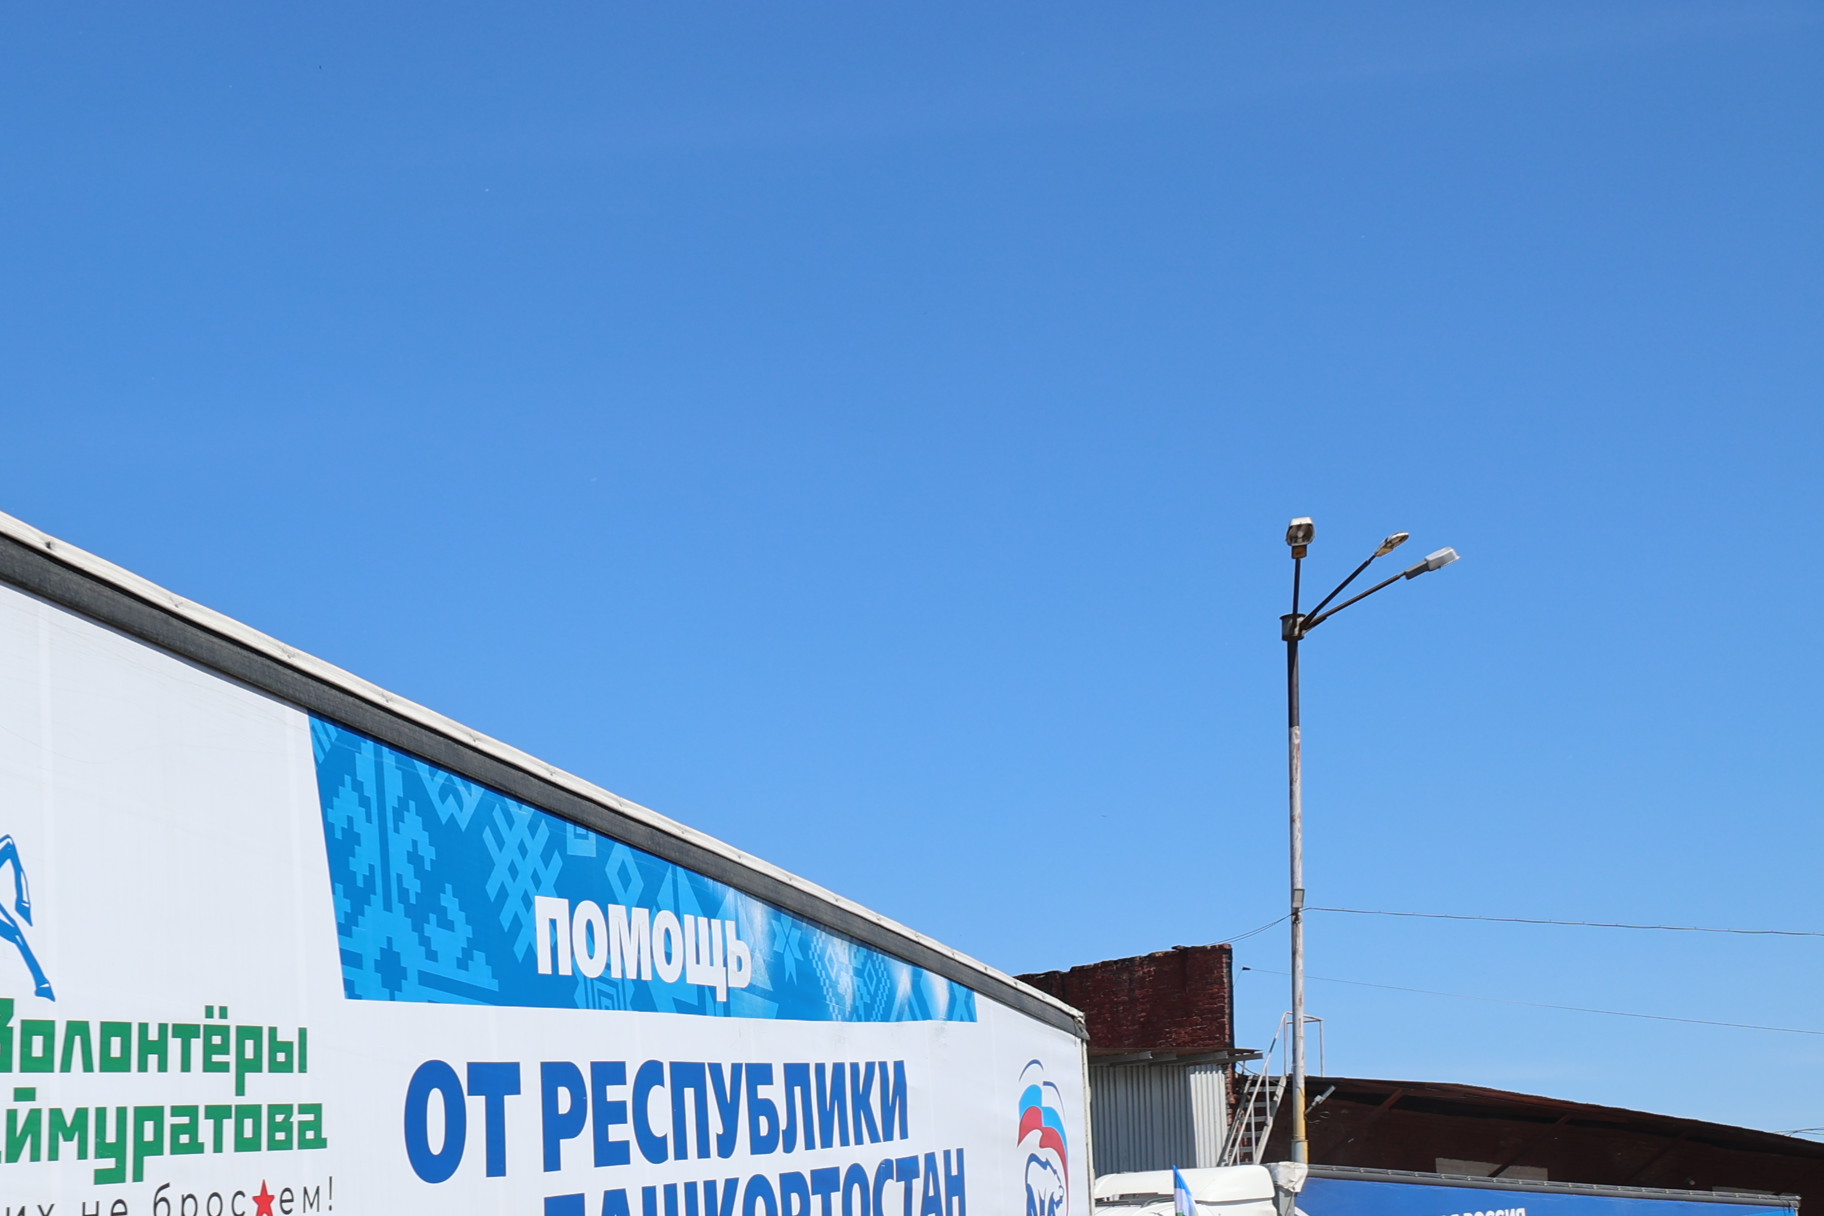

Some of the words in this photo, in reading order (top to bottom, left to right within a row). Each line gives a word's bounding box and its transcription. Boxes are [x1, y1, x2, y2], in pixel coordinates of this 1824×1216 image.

[534, 895, 752, 1001] ПОМОЩЬ
[403, 1059, 522, 1184] ОТ
[540, 1059, 909, 1173] РЕСПУБЛИКИ
